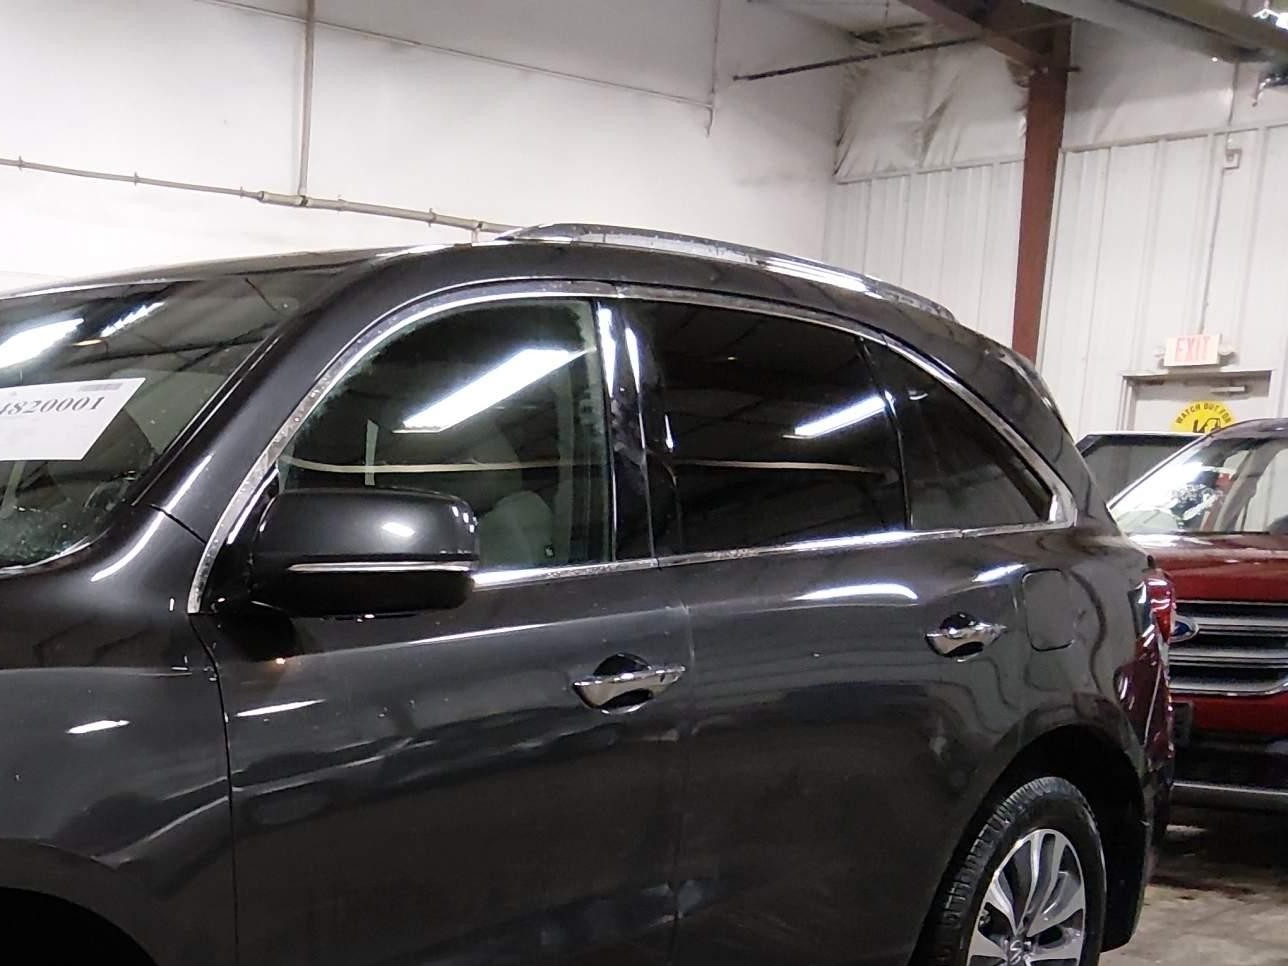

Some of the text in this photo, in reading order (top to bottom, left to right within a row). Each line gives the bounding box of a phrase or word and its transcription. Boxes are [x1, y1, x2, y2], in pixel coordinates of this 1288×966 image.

[1176, 338, 1209, 361] EXIT
[1176, 403, 1231, 423] WATCH OUT FOR
